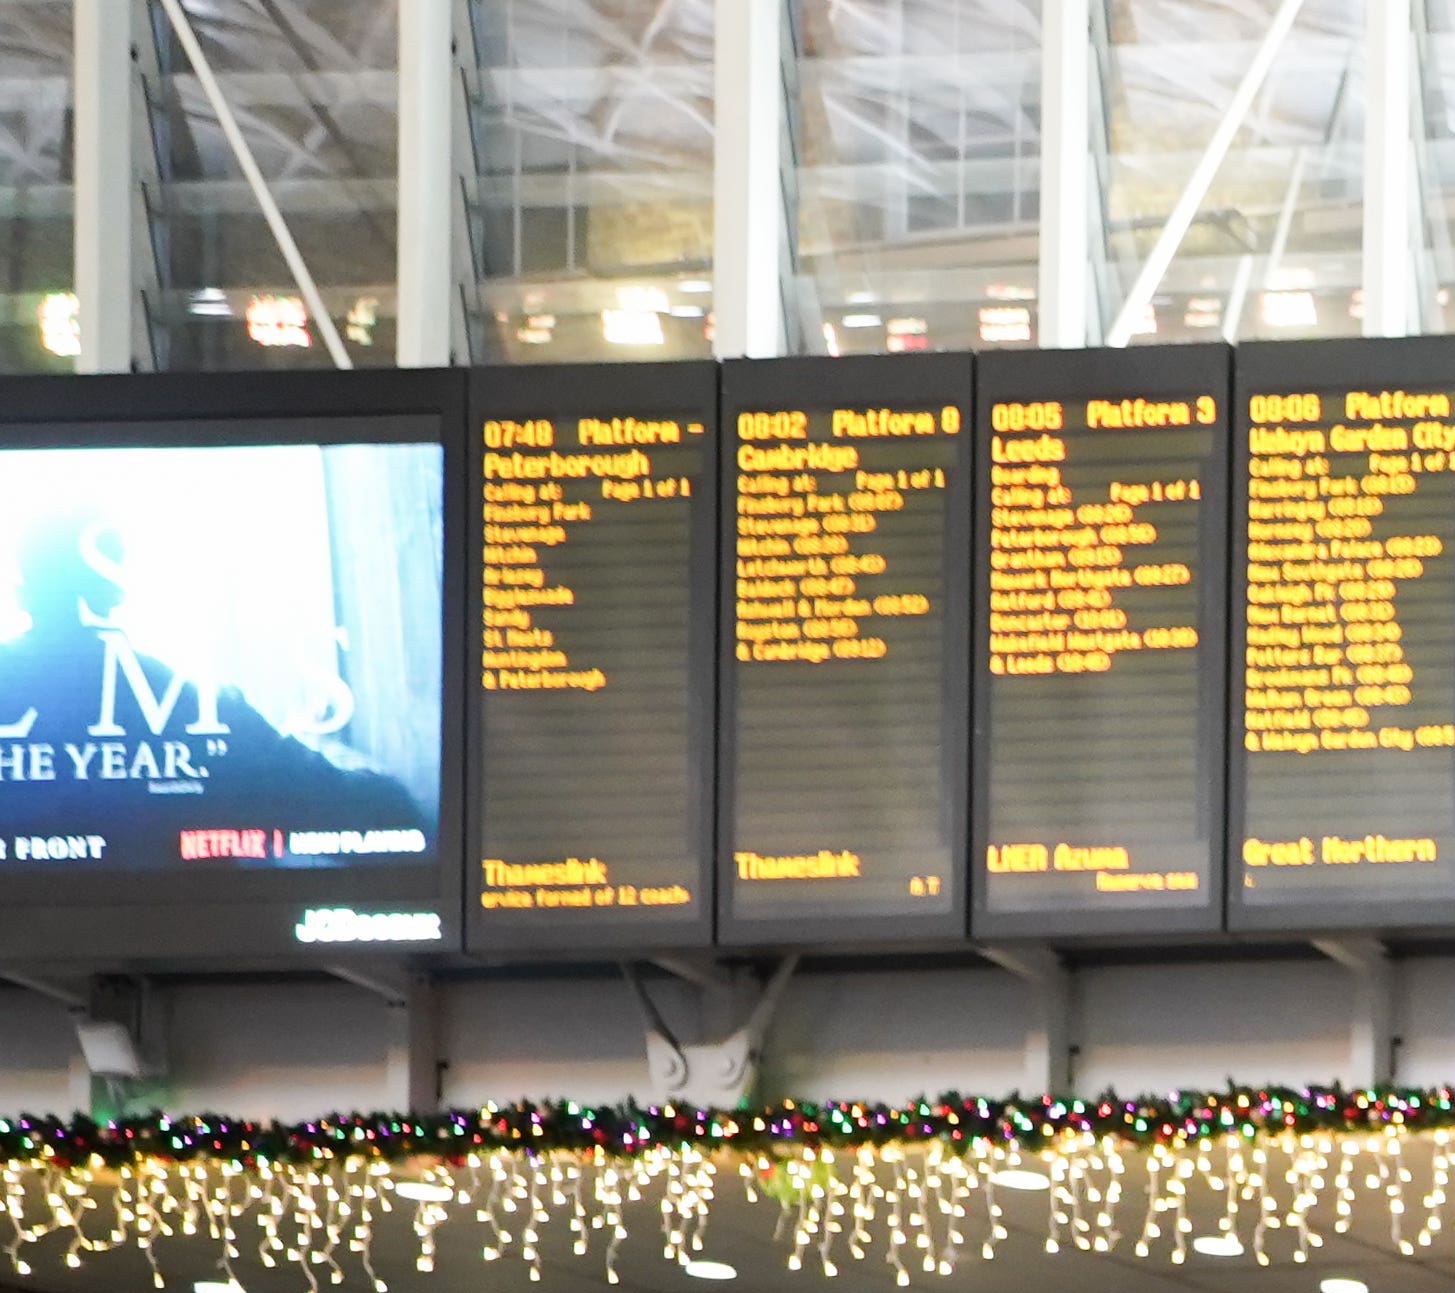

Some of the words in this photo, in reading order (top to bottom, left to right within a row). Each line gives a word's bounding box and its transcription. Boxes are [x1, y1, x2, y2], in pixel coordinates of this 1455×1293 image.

[1087, 399, 1190, 428] Platform
[1345, 391, 1452, 420] Platform
[578, 418, 680, 445] Platform
[833, 409, 936, 437] Platform
[992, 435, 1066, 463] Leeds
[1249, 426, 1326, 457] Welwyn
[1329, 423, 1410, 452] Garden
[484, 449, 650, 479] Peterborough
[738, 443, 859, 472] Cambridge
[0, 743, 56, 781] HE
[14, 834, 107, 860] FRONT
[180, 829, 267, 860] NETFLIX
[1242, 839, 1316, 866] Great
[1320, 835, 1437, 864] Northern
[483, 858, 608, 886] Thameslink
[734, 850, 861, 880] Thameslink
